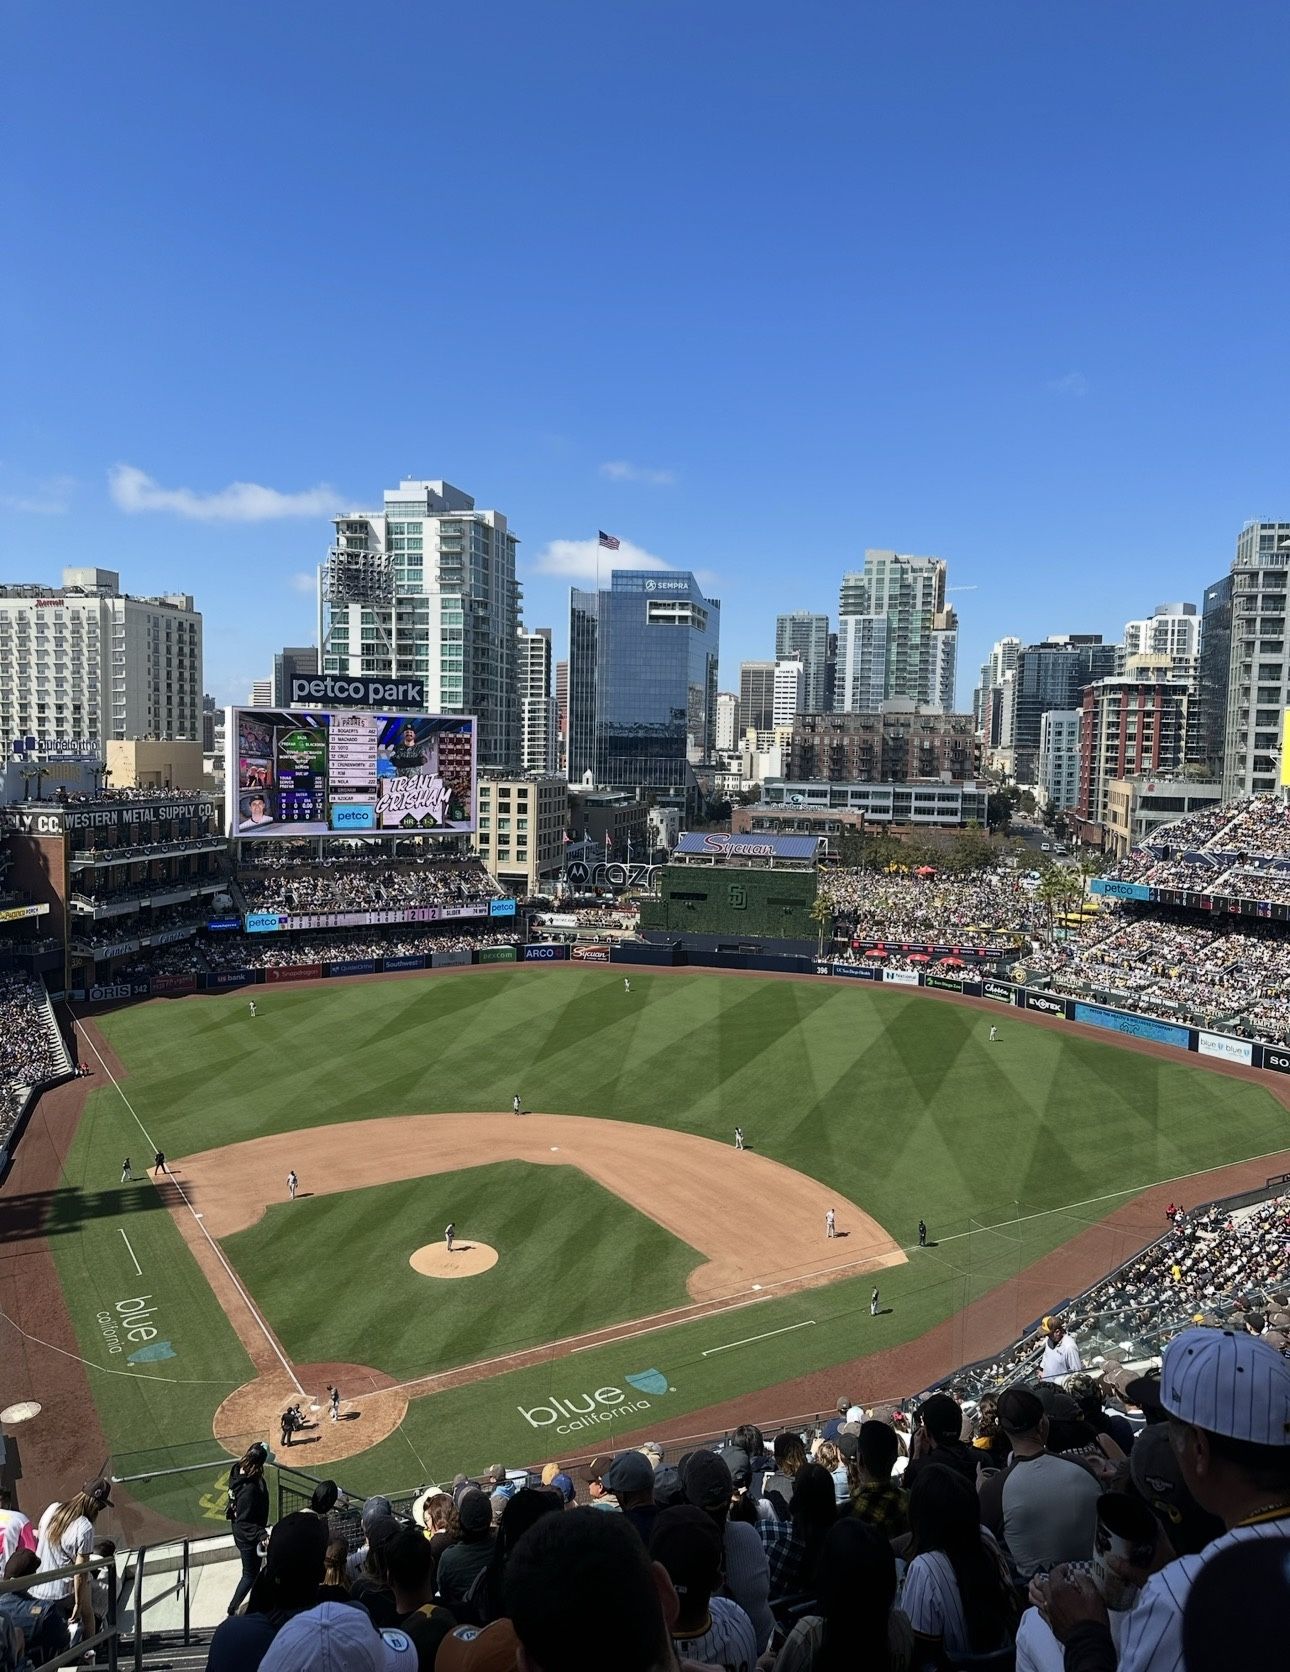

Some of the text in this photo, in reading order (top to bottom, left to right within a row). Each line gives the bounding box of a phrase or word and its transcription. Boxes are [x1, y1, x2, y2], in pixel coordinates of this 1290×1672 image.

[292, 677, 421, 704] petco park
[390, 773, 439, 793] TRENT
[375, 787, 452, 814] GRISHAM
[65, 803, 214, 830] WESTERN METAL SUPPLY CO.
[337, 810, 369, 823] petco
[37, 815, 63, 833] CO.
[703, 833, 777, 859] Sycuan
[592, 862, 662, 888] razr
[1104, 883, 1133, 897] petco
[1192, 896, 1196, 904] F
[1219, 900, 1224, 908] F
[492, 903, 514, 915] petco
[1248, 903, 1252, 911] F
[1278, 908, 1282, 916] F
[411, 910, 416, 920] 2
[421, 910, 425, 919] 1
[431, 909, 436, 919] 2
[248, 918, 277, 929] petco
[526, 949, 554, 958] ARCO
[573, 946, 606, 960] Sycuan
[385, 960, 418, 968] Southwest
[281, 969, 319, 978] Snapdragon
[816, 966, 828, 975] 396
[227, 973, 246, 982] bank
[91, 987, 130, 1000] ORIS
[134, 985, 148, 994] 342
[984, 983, 1009, 996] Chosen
[1028, 998, 1061, 1011] EVOTEK
[1110, 1013, 1126, 1021] HEALTH
[1152, 1023, 1174, 1032] COMPANY
[1200, 1038, 1217, 1048] blue
[1225, 1044, 1243, 1054] blue
[1269, 1056, 1290, 1068] SO
[114, 1295, 158, 1342] blue
[96, 1311, 125, 1354] california
[516, 1386, 625, 1428] blue
[556, 1400, 651, 1435] california
